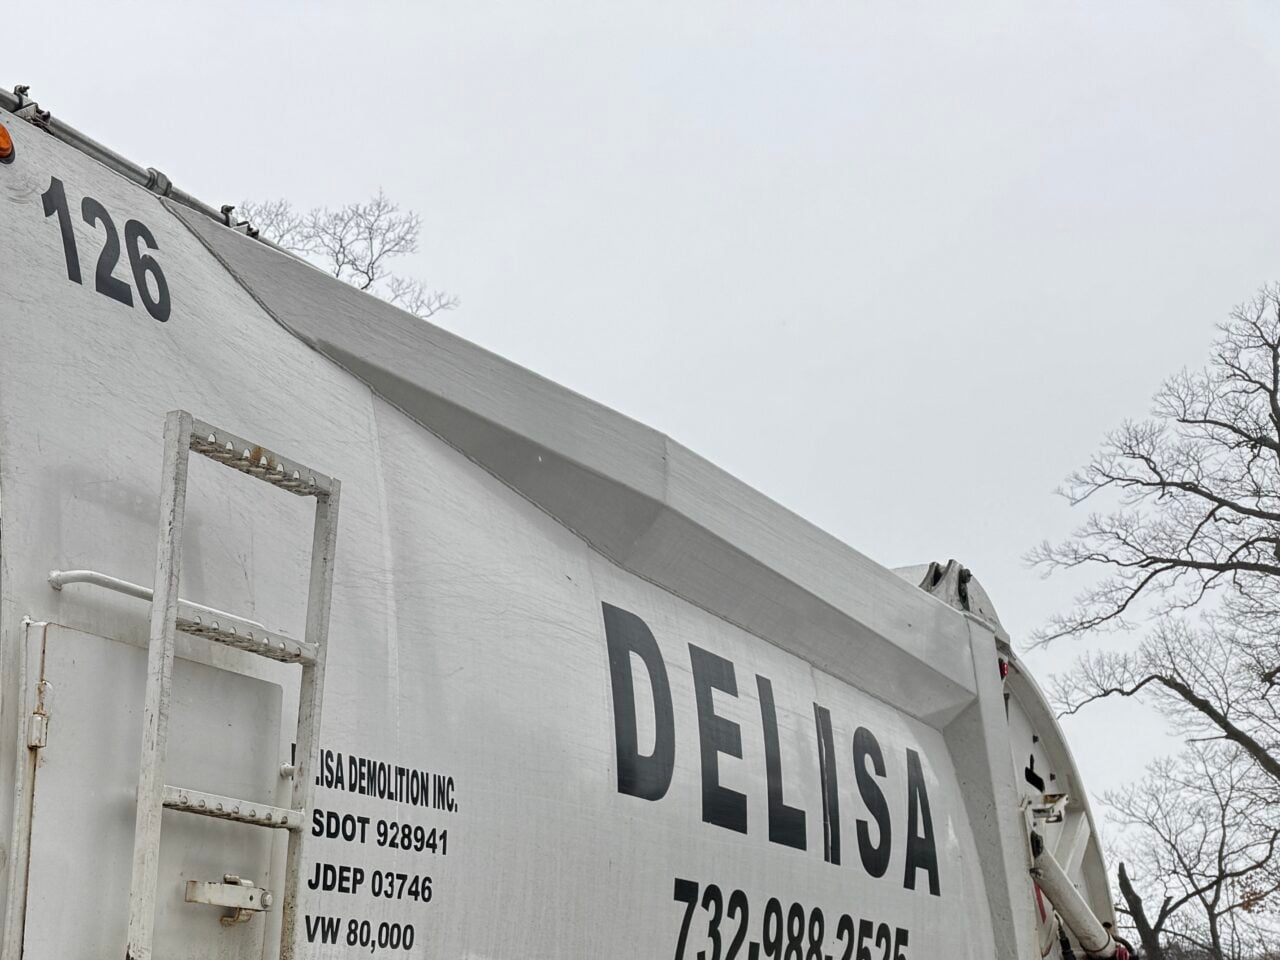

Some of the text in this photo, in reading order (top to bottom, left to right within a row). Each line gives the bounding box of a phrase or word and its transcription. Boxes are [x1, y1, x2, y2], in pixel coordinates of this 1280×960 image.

[40, 176, 172, 323] 126
[601, 600, 941, 897] DELISA
[348, 754, 429, 808] DEMOLITION
[432, 773, 458, 813] INC.
[311, 808, 448, 855] SDOT 928941
[307, 862, 433, 902] JDEP 03746
[304, 915, 414, 953] VW 80,000
